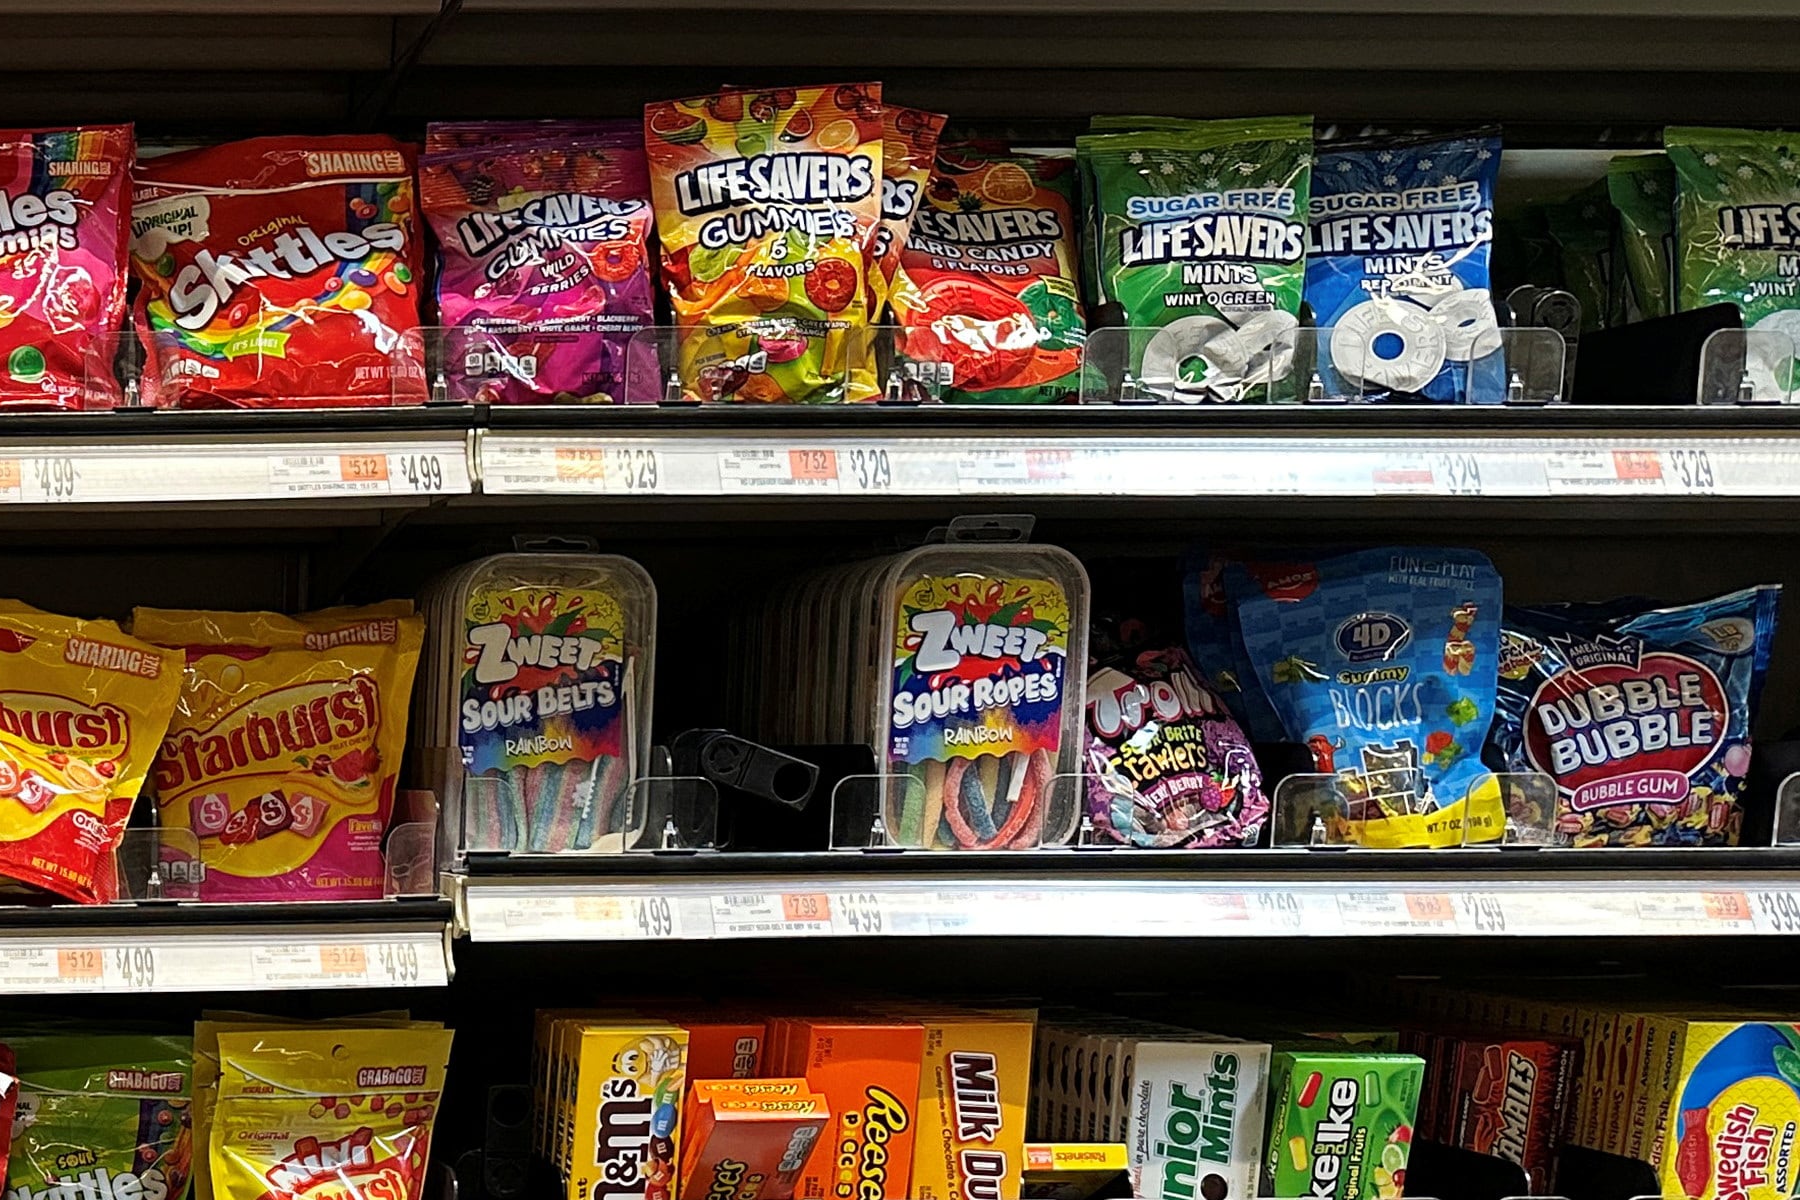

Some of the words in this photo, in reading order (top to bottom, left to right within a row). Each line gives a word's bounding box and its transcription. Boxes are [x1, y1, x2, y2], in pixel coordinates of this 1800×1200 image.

[307, 152, 384, 174] SHARING
[1128, 190, 1219, 216] SUGAR
[1227, 188, 1294, 212] FREE
[169, 223, 403, 329] Skittles
[1165, 293, 1202, 306] WINT
[1206, 292, 1217, 305] O
[1223, 291, 1275, 304] GREEN
[1183, 264, 1256, 284] MINTS
[66, 636, 142, 674] SHARING
[472, 623, 600, 683] ZWEET
[912, 612, 1046, 672] ZWEET
[894, 685, 968, 728] SOUR
[973, 674, 1057, 710] ROPES
[1339, 667, 1406, 683] Gummy
[464, 691, 534, 734] SOUR
[539, 679, 614, 716] BELTS
[1335, 685, 1421, 728] BLOCKS
[1542, 675, 1702, 734] DUBBLE
[158, 686, 378, 790] Starburst
[506, 735, 572, 756] RAINBOW
[945, 725, 1012, 744] RAINBOW
[1555, 715, 1713, 774] BUBBLE
[1582, 783, 1636, 802] BUBBLE
[1642, 779, 1678, 797] GUM
[1201, 1050, 1241, 1164] Mints
[1316, 1078, 1358, 1141] Ike
[942, 1128, 954, 1180] Chocolate
[1314, 1140, 1347, 1156] and
[1350, 1125, 1367, 1158] Fruits
[1740, 1125, 1772, 1193] Fish
[1776, 1120, 1797, 1194] ASSORTED
